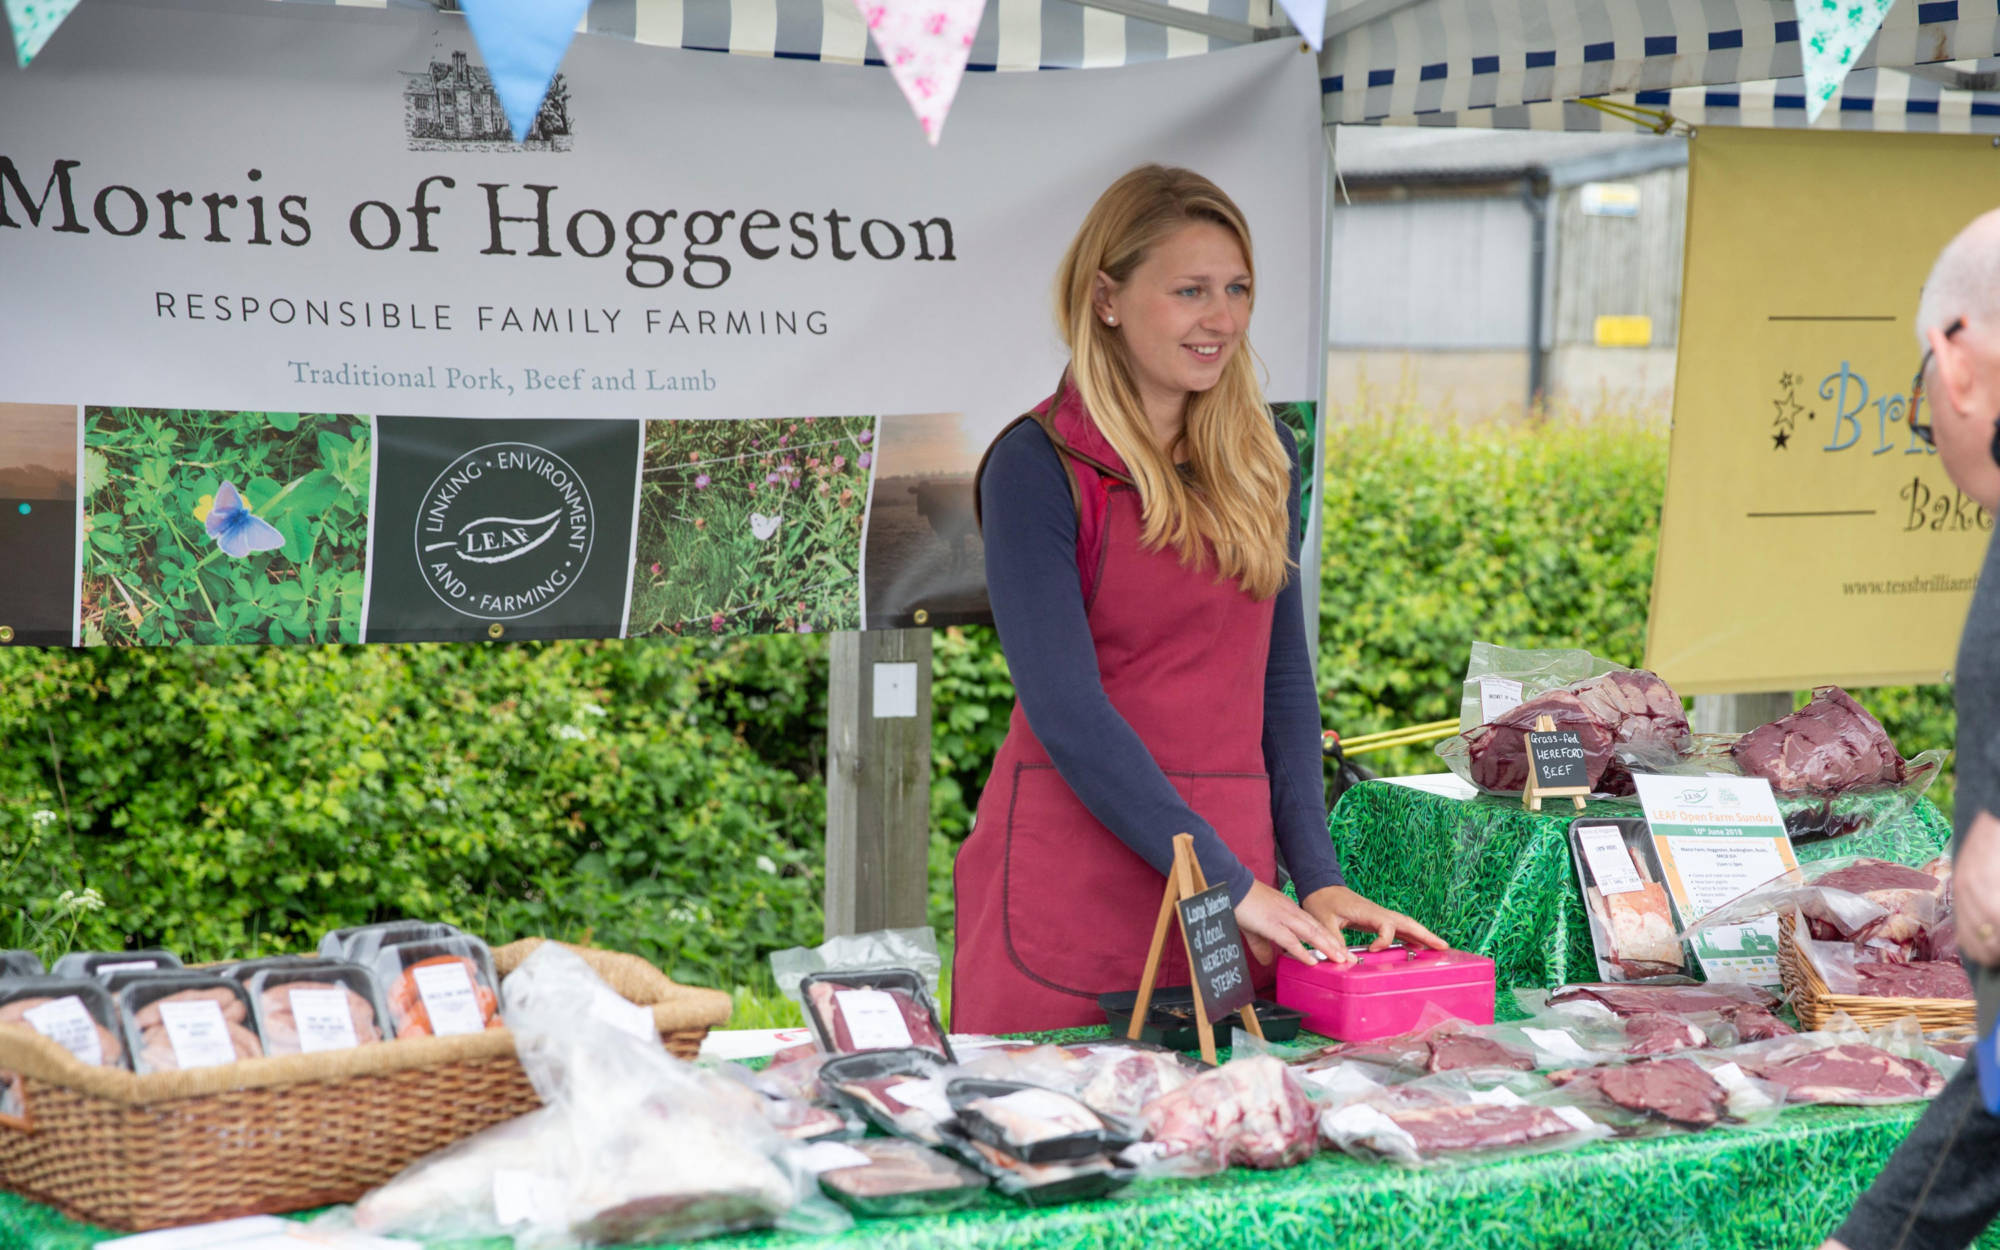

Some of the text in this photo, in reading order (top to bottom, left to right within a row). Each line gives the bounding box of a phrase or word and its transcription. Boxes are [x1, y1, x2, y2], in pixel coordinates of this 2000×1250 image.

[0, 155, 957, 289] Morris of Hoggeston
[155, 291, 829, 336] RESPONSIBLE FAMILY FARMING
[287, 360, 717, 396] Traditional Pork, Beef and Lamb
[425, 451, 588, 553] LINKING ENVIRONMENT
[465, 527, 532, 553] LEAF
[430, 561, 568, 612] AND FARMING
[1530, 732, 1580, 744] Grass-fed
[1536, 747, 1584, 760] HEREFORD
[1542, 764, 1574, 779] BEEF
[1654, 810, 1774, 824] LEAF Open Farm Sunday
[1200, 943, 1240, 974] HEREFORD
[1210, 966, 1242, 998] STEAKS
